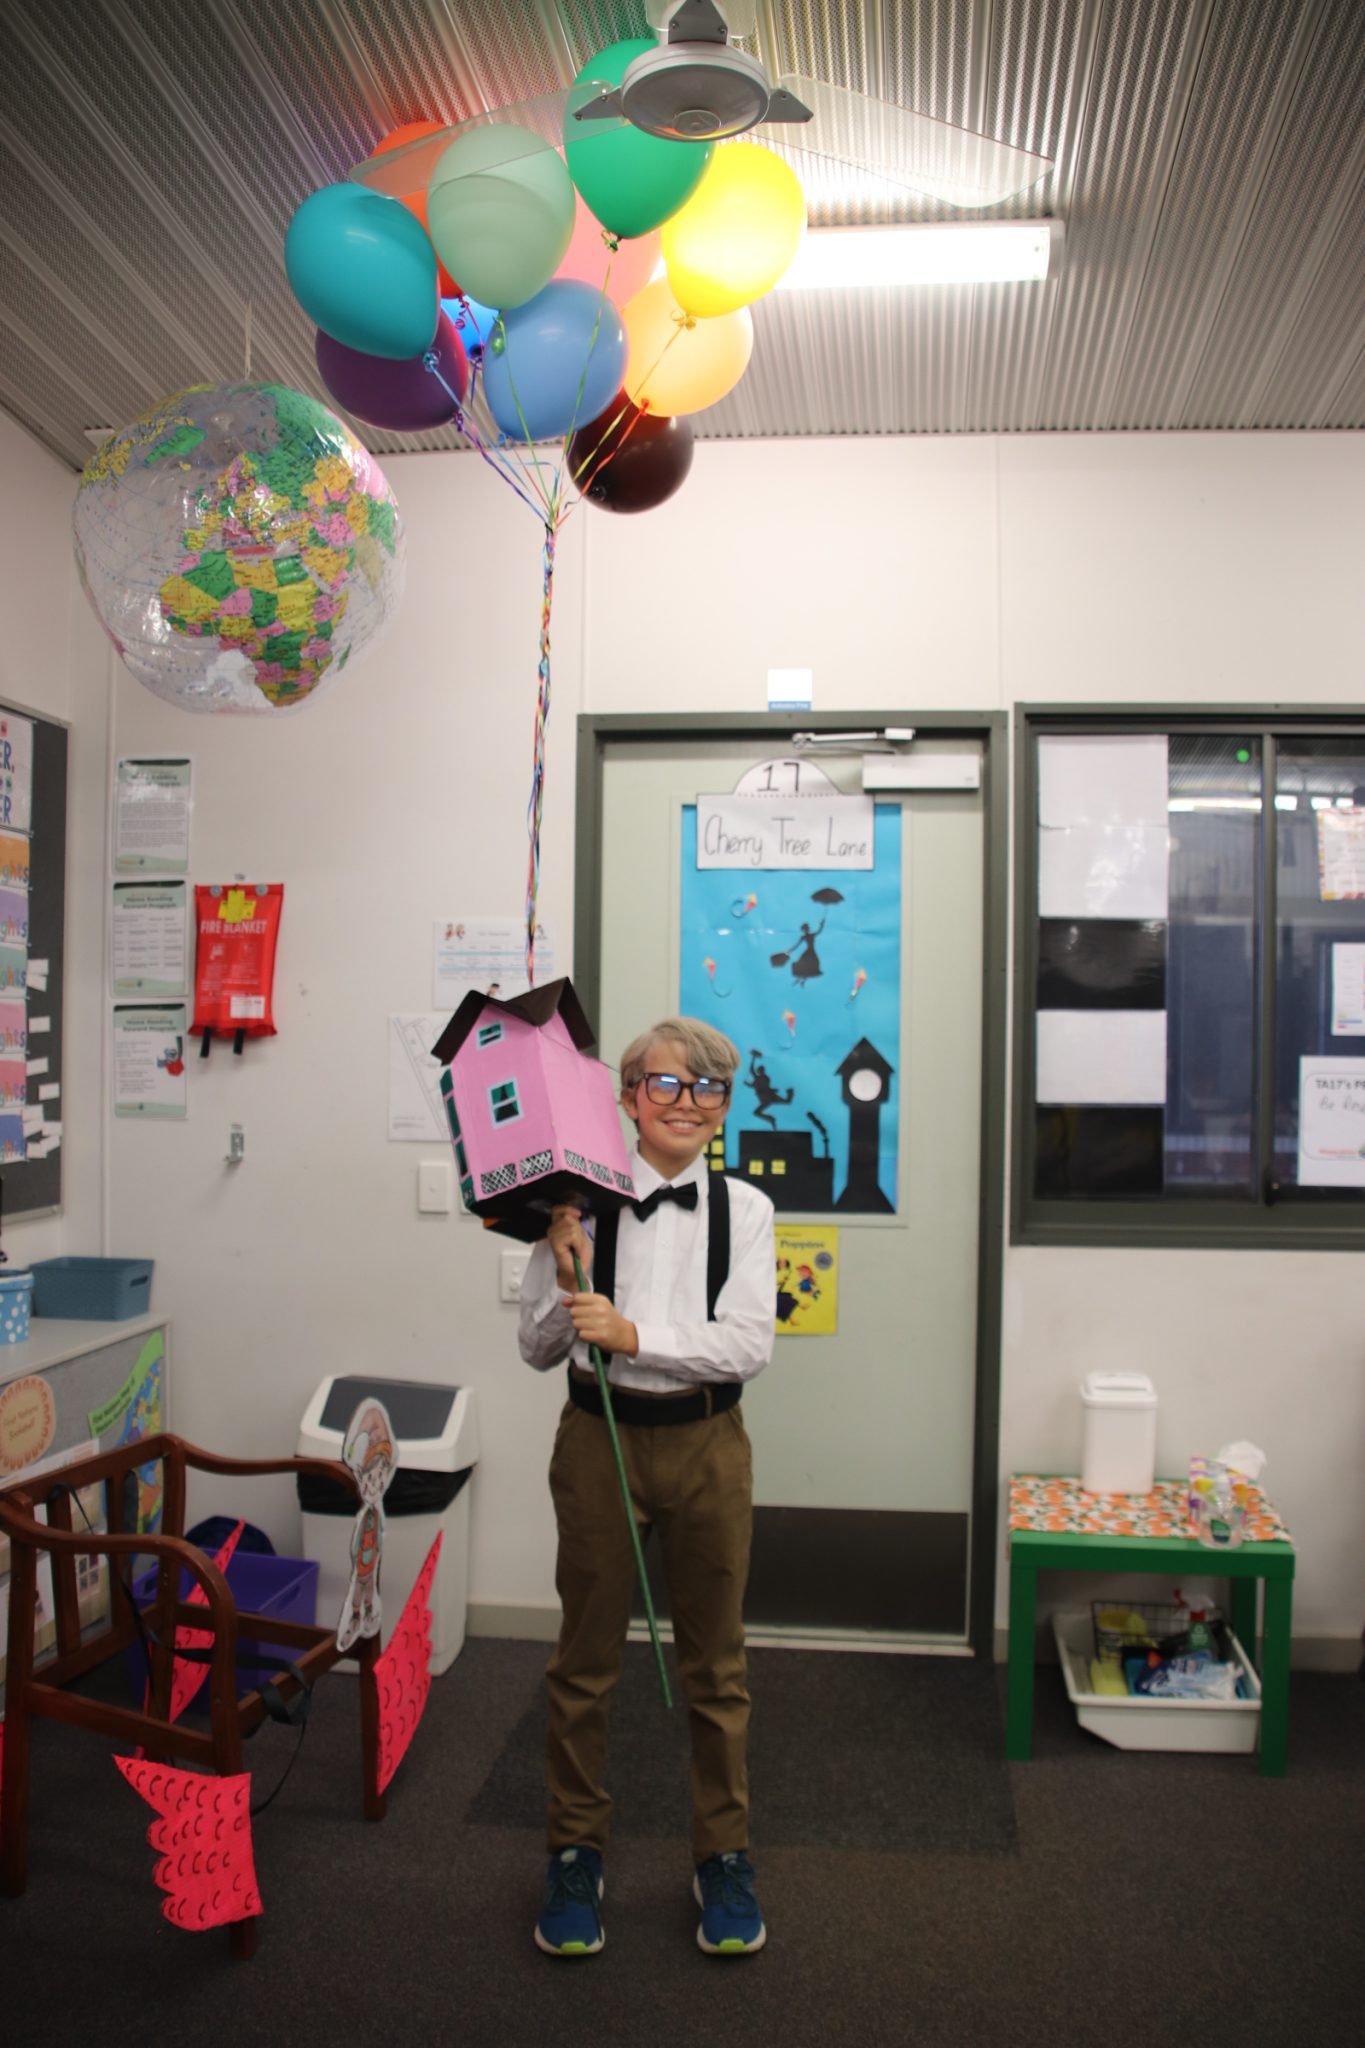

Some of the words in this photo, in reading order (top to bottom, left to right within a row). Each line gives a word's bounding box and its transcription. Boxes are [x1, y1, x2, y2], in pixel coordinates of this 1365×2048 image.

[757, 762, 799, 792] 17
[704, 814, 763, 866] Cherry
[771, 817, 811, 855] Tree
[827, 816, 867, 856] Lane
[201, 919, 221, 934] FIRE
[224, 919, 268, 934] BLANKET
[780, 1239, 825, 1250] Poppins
